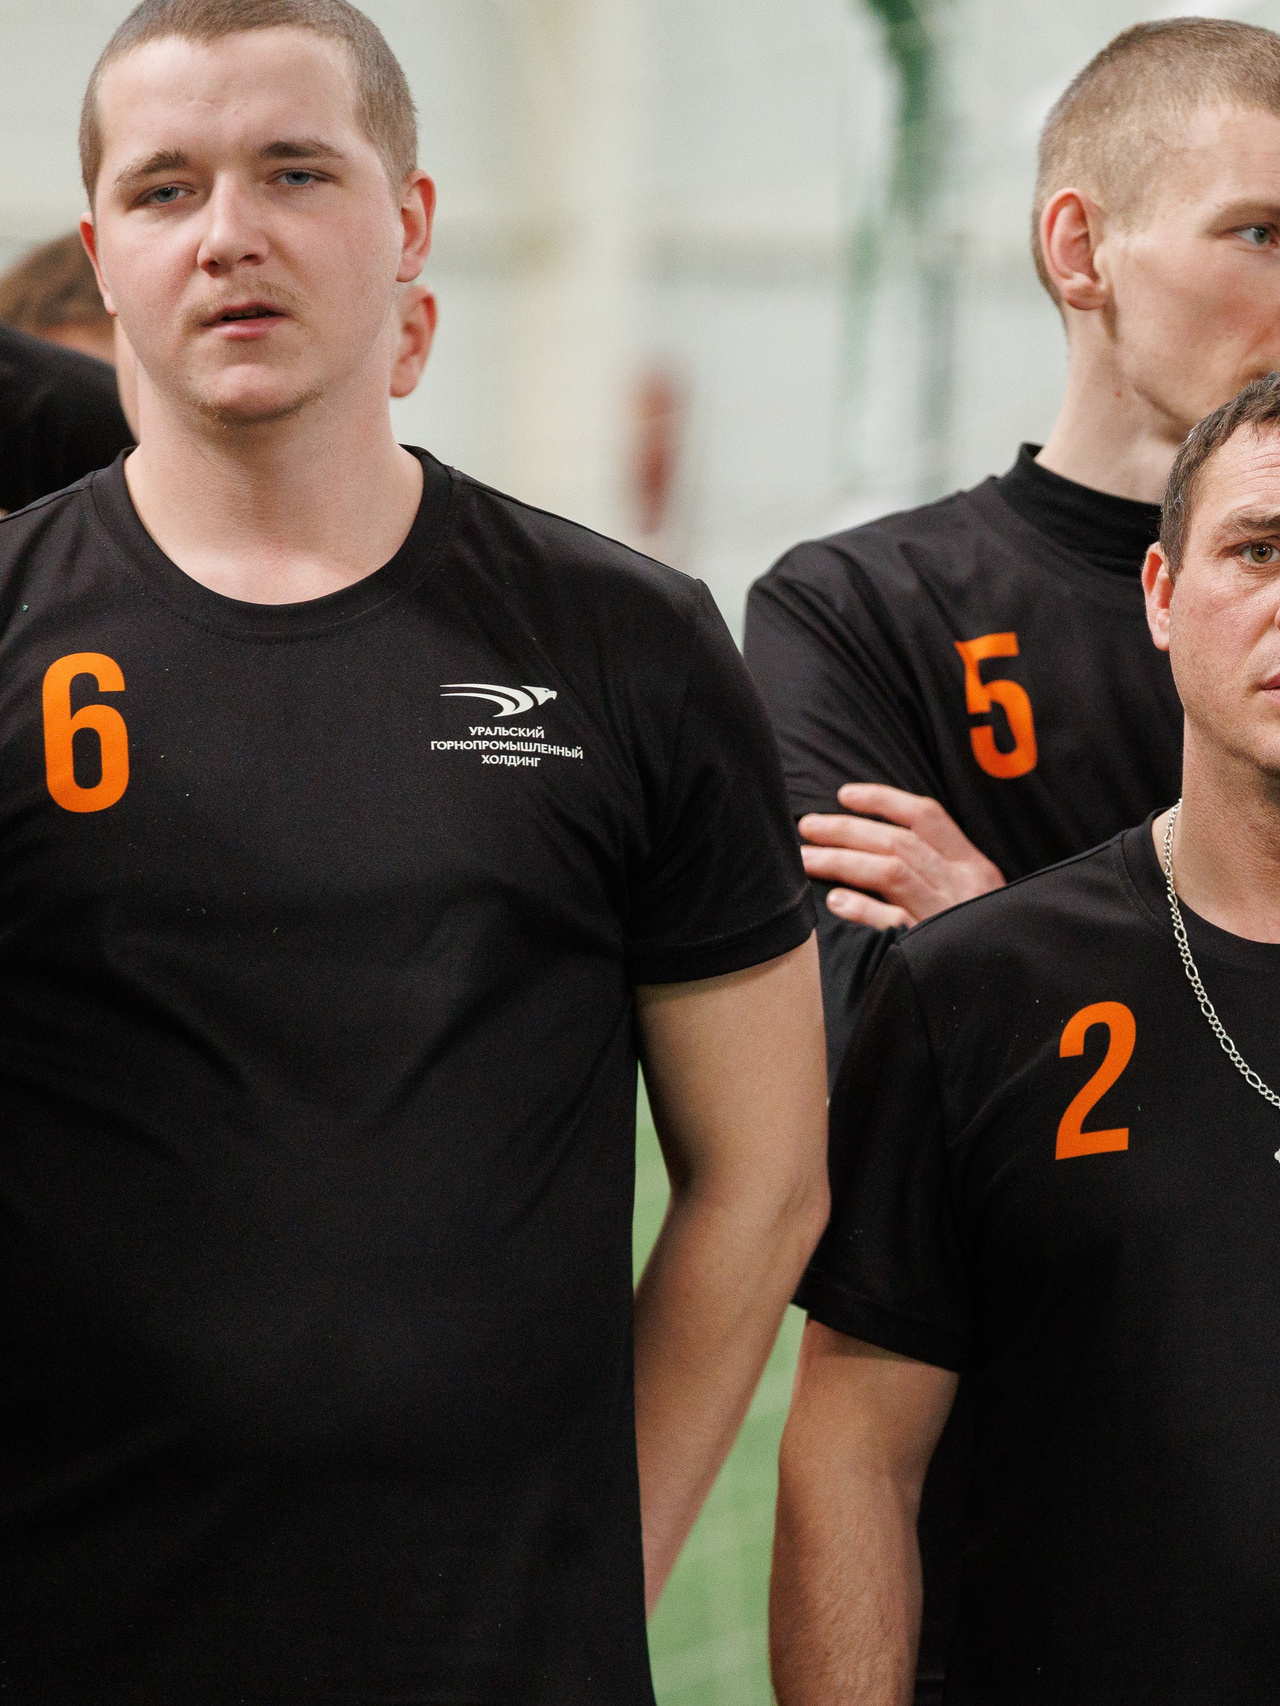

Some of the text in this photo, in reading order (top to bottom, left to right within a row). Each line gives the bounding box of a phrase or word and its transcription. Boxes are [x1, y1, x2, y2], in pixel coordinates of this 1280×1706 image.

[40, 653, 130, 813] 6
[468, 726, 545, 739] УРАЛЬСКИЙ
[955, 632, 1037, 778] 5
[430, 740, 584, 760] ГОРНОПРОМЫШЛЕННЫЙ
[481, 754, 542, 767] ХОЛДИНГ
[1055, 1000, 1137, 1160] 2
